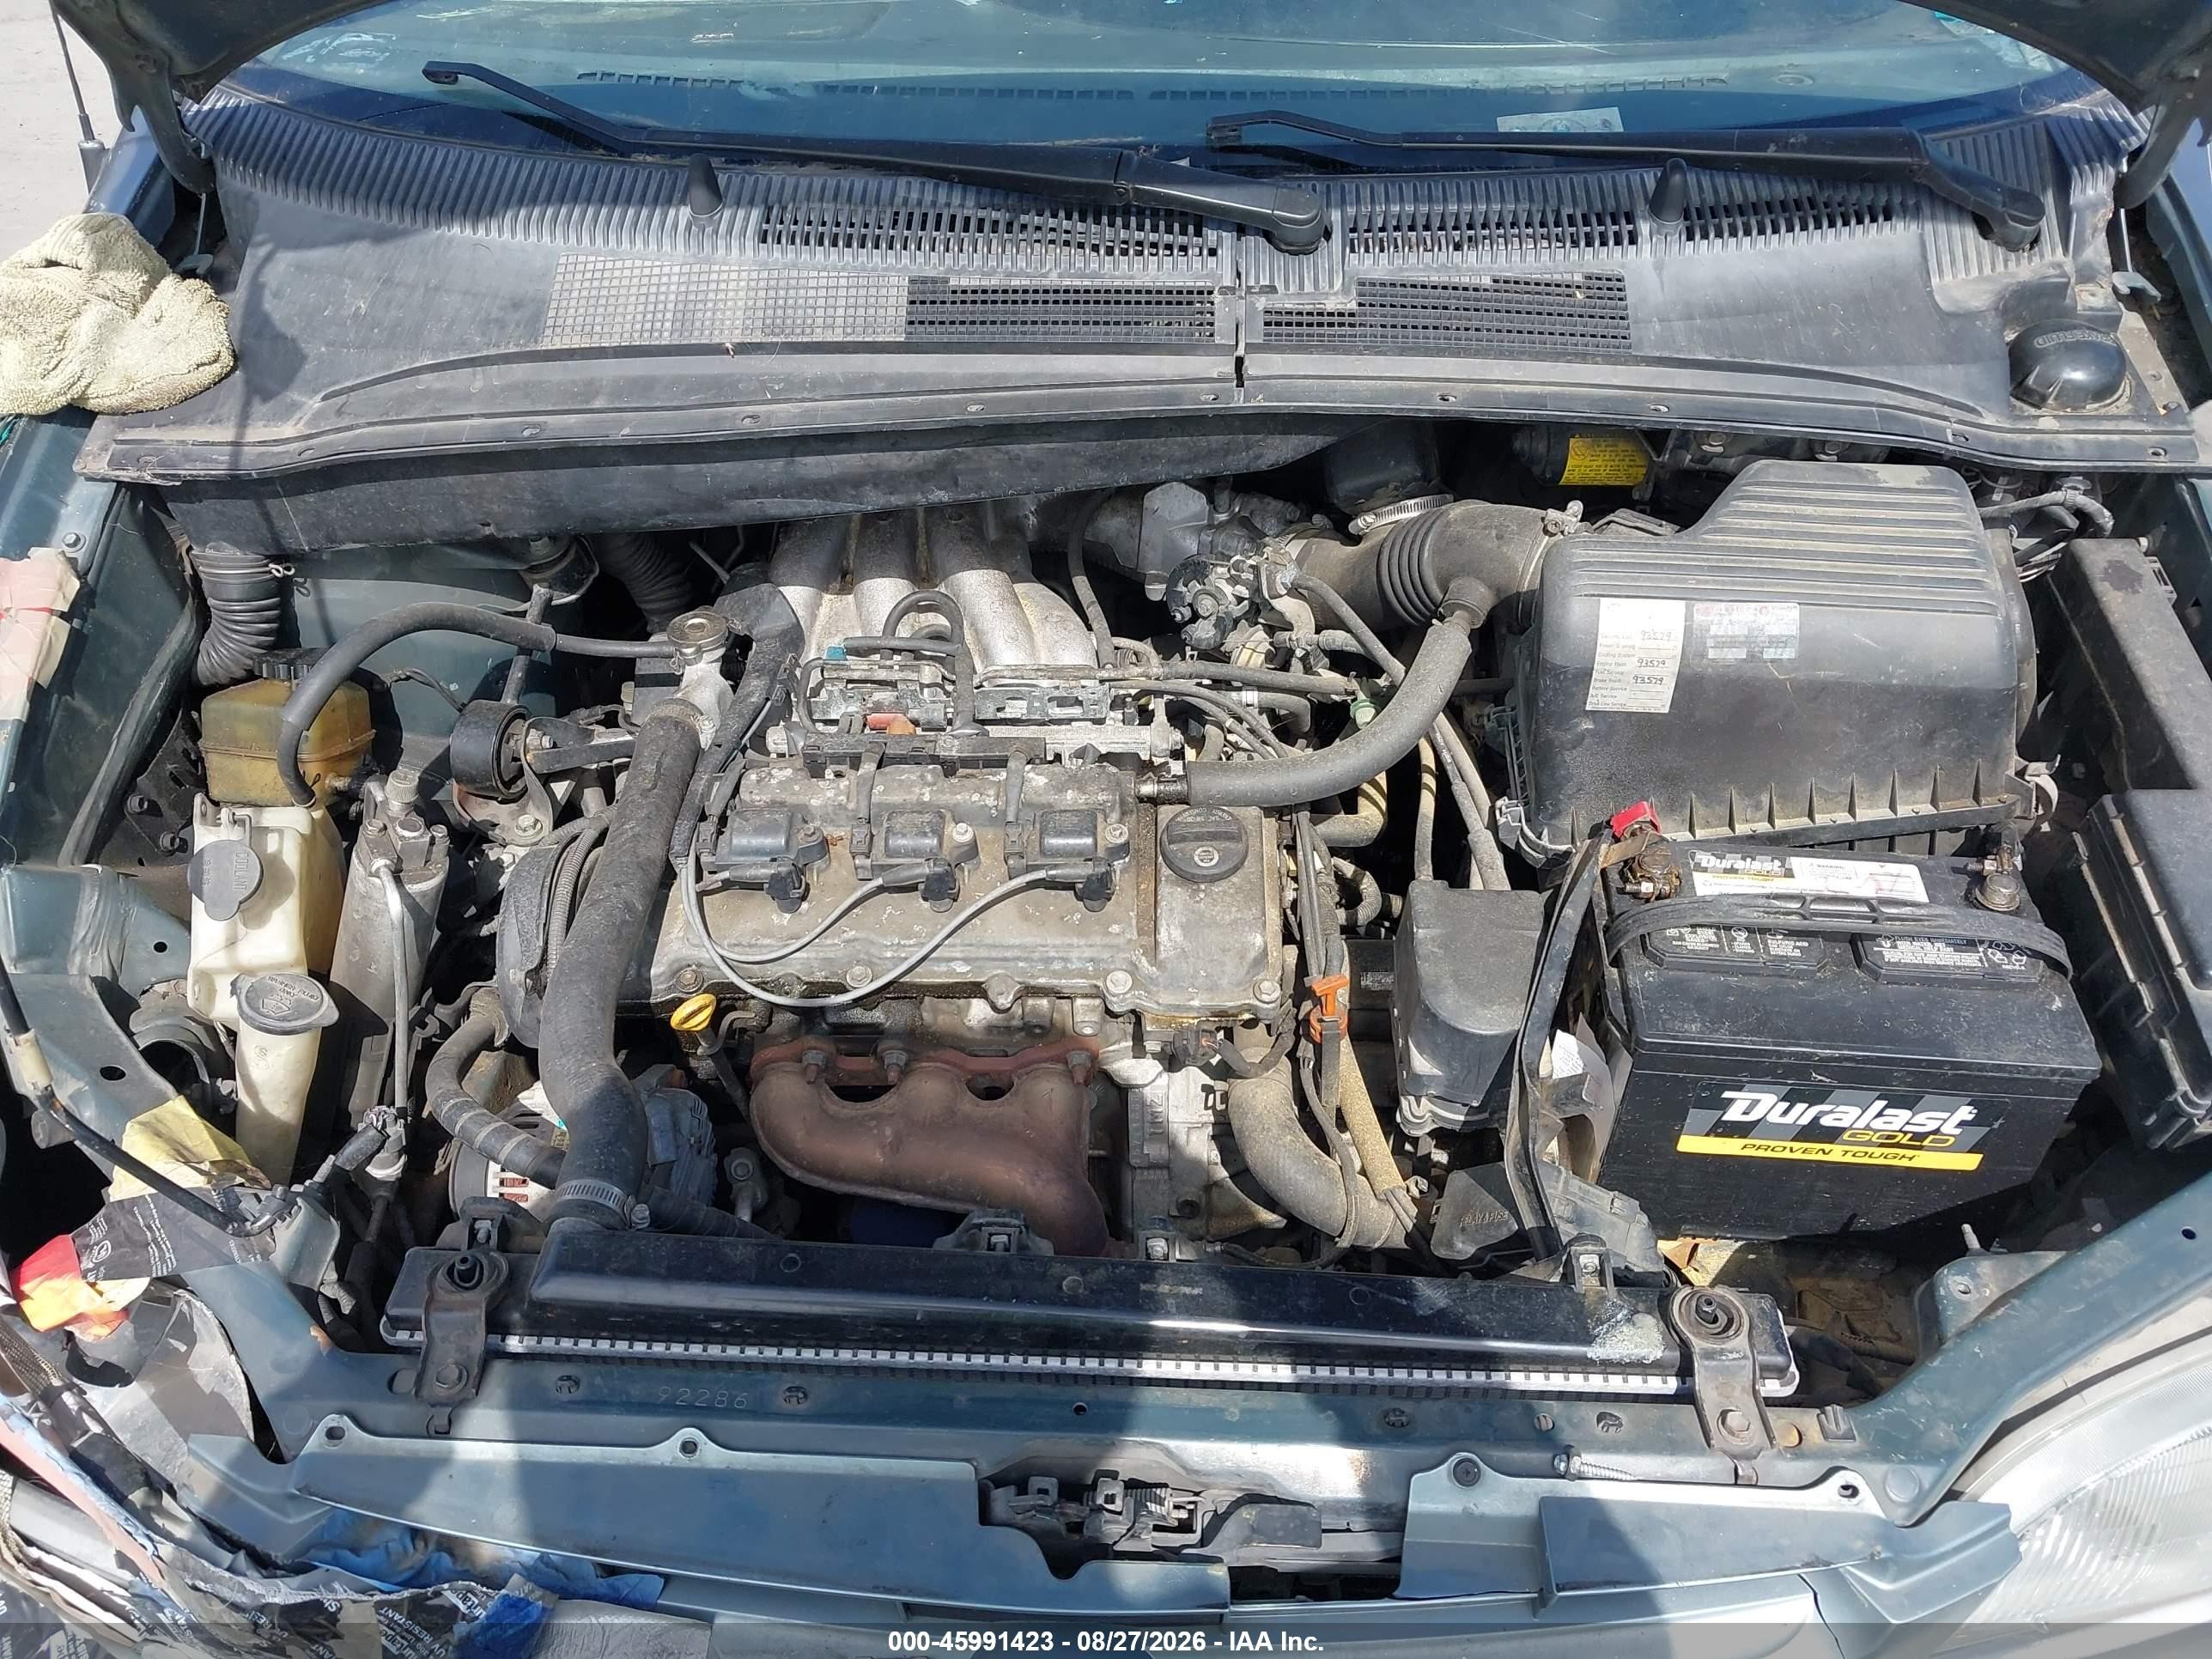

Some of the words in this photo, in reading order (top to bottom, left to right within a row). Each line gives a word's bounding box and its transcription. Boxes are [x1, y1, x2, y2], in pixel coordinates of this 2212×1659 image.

[1637, 658, 1667, 668] 93579
[1632, 675, 1664, 686] 93579
[233, 852, 249, 891] COOLANT
[1695, 854, 1783, 872] Duralast
[1720, 1090, 1978, 1136] Duralast
[1842, 1129, 1956, 1148] GOLD
[1740, 1143, 1834, 1157] PROVEN
[1840, 1148, 1920, 1163] TOUGH
[659, 1385, 749, 1409] 92286
[379, 1607, 434, 1644] RESISTANT
[429, 1643, 447, 1658] UV
